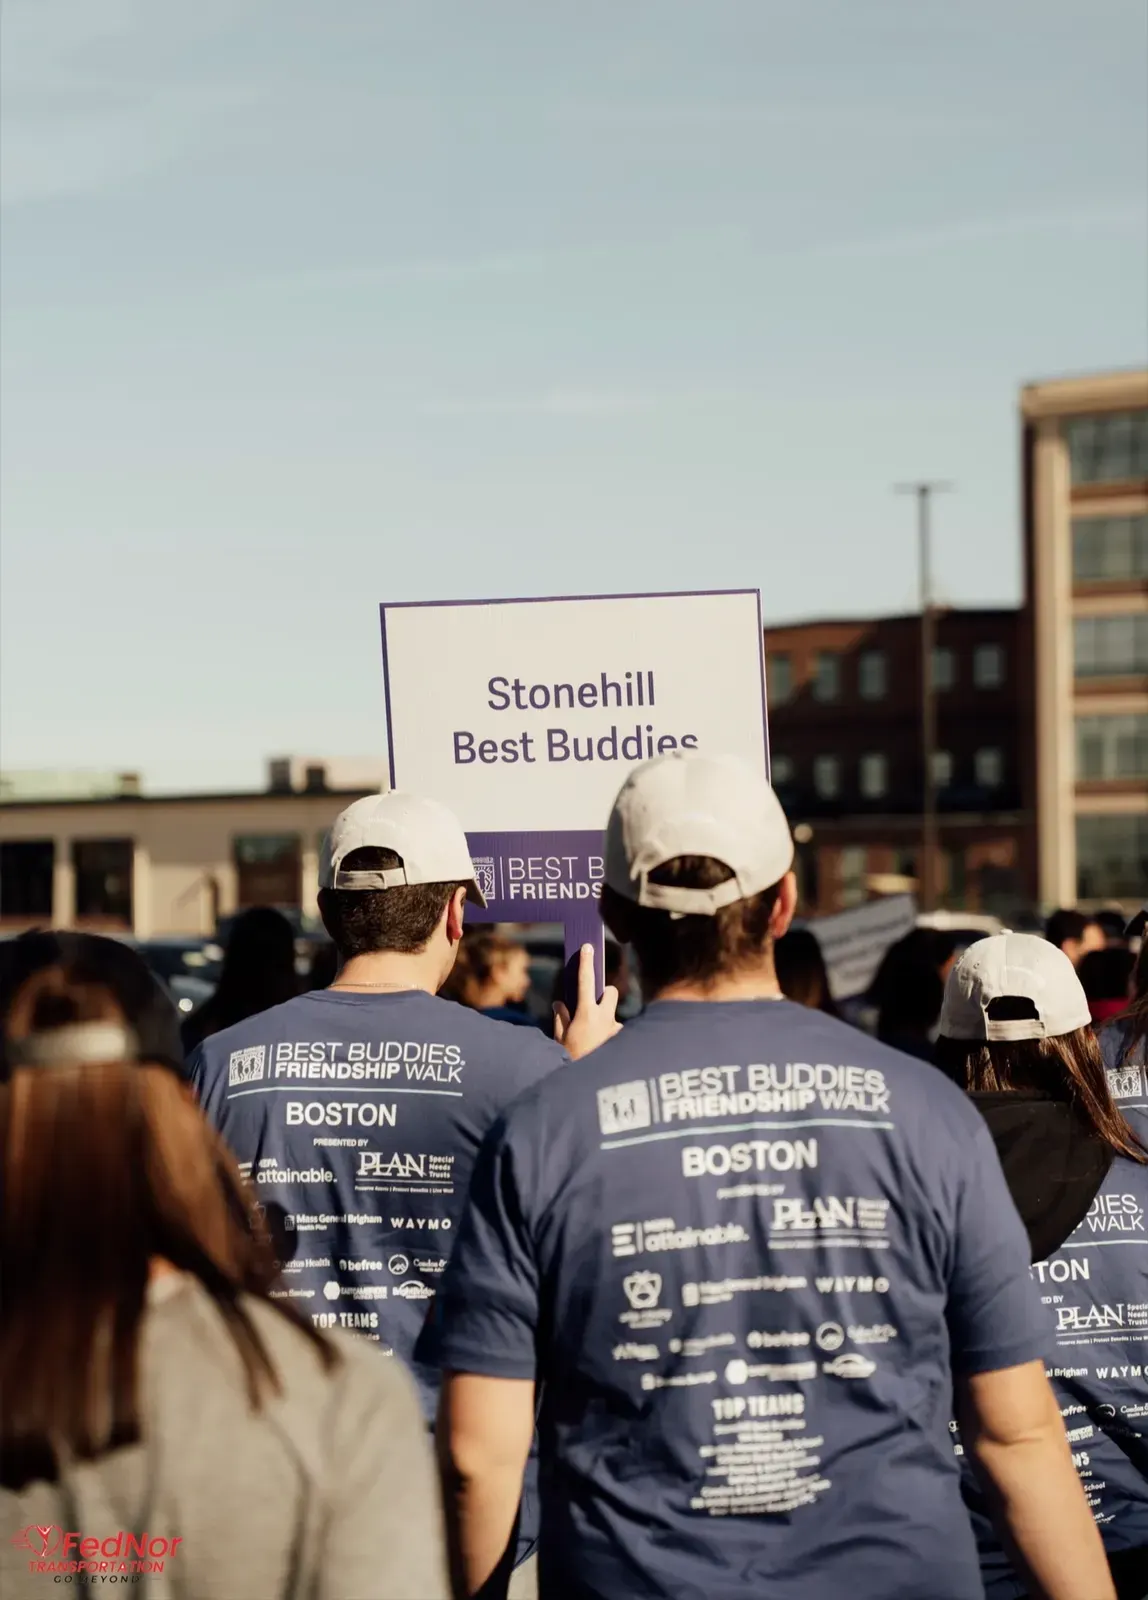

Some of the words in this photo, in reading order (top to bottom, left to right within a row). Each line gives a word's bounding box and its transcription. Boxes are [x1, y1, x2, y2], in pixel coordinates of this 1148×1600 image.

[488, 670, 656, 711] Stonehill
[453, 730, 536, 764] Best
[547, 724, 699, 763] Buddies
[508, 856, 579, 880] BEST
[509, 882, 603, 900] FRIENDS
[276, 1042, 343, 1062] BEST
[275, 1062, 400, 1079] FRIENDSHIP
[405, 1064, 463, 1083] WALK
[659, 1065, 741, 1100] BEST
[286, 1102, 398, 1127] BOSTON
[662, 1089, 816, 1122] FRIENDSHIP
[819, 1090, 891, 1113] WALK
[313, 1138, 356, 1147] PRESENTED
[357, 1138, 368, 1148] BY
[356, 1151, 427, 1177] PLAN
[429, 1155, 455, 1164] Special
[682, 1138, 818, 1177] BOSTON
[429, 1171, 451, 1179] Trusts
[296, 1214, 318, 1224] Mass
[347, 1214, 383, 1226] Brigham
[772, 1195, 856, 1231] PLAN
[390, 1217, 452, 1230] WAYMO
[1087, 1215, 1145, 1232] WALK
[305, 1257, 331, 1268] Health
[348, 1259, 383, 1271] befree
[1029, 1257, 1090, 1284] TON
[816, 1276, 890, 1293] WAYMO
[1053, 1295, 1064, 1303] BY
[312, 1313, 337, 1328] TOP
[339, 1312, 379, 1328] TEAMS
[1055, 1304, 1126, 1330] PLAN
[1054, 1368, 1089, 1378] Brigham
[711, 1396, 745, 1420] TOP
[748, 1392, 805, 1416] TEAMS
[1084, 1481, 1105, 1492] School
